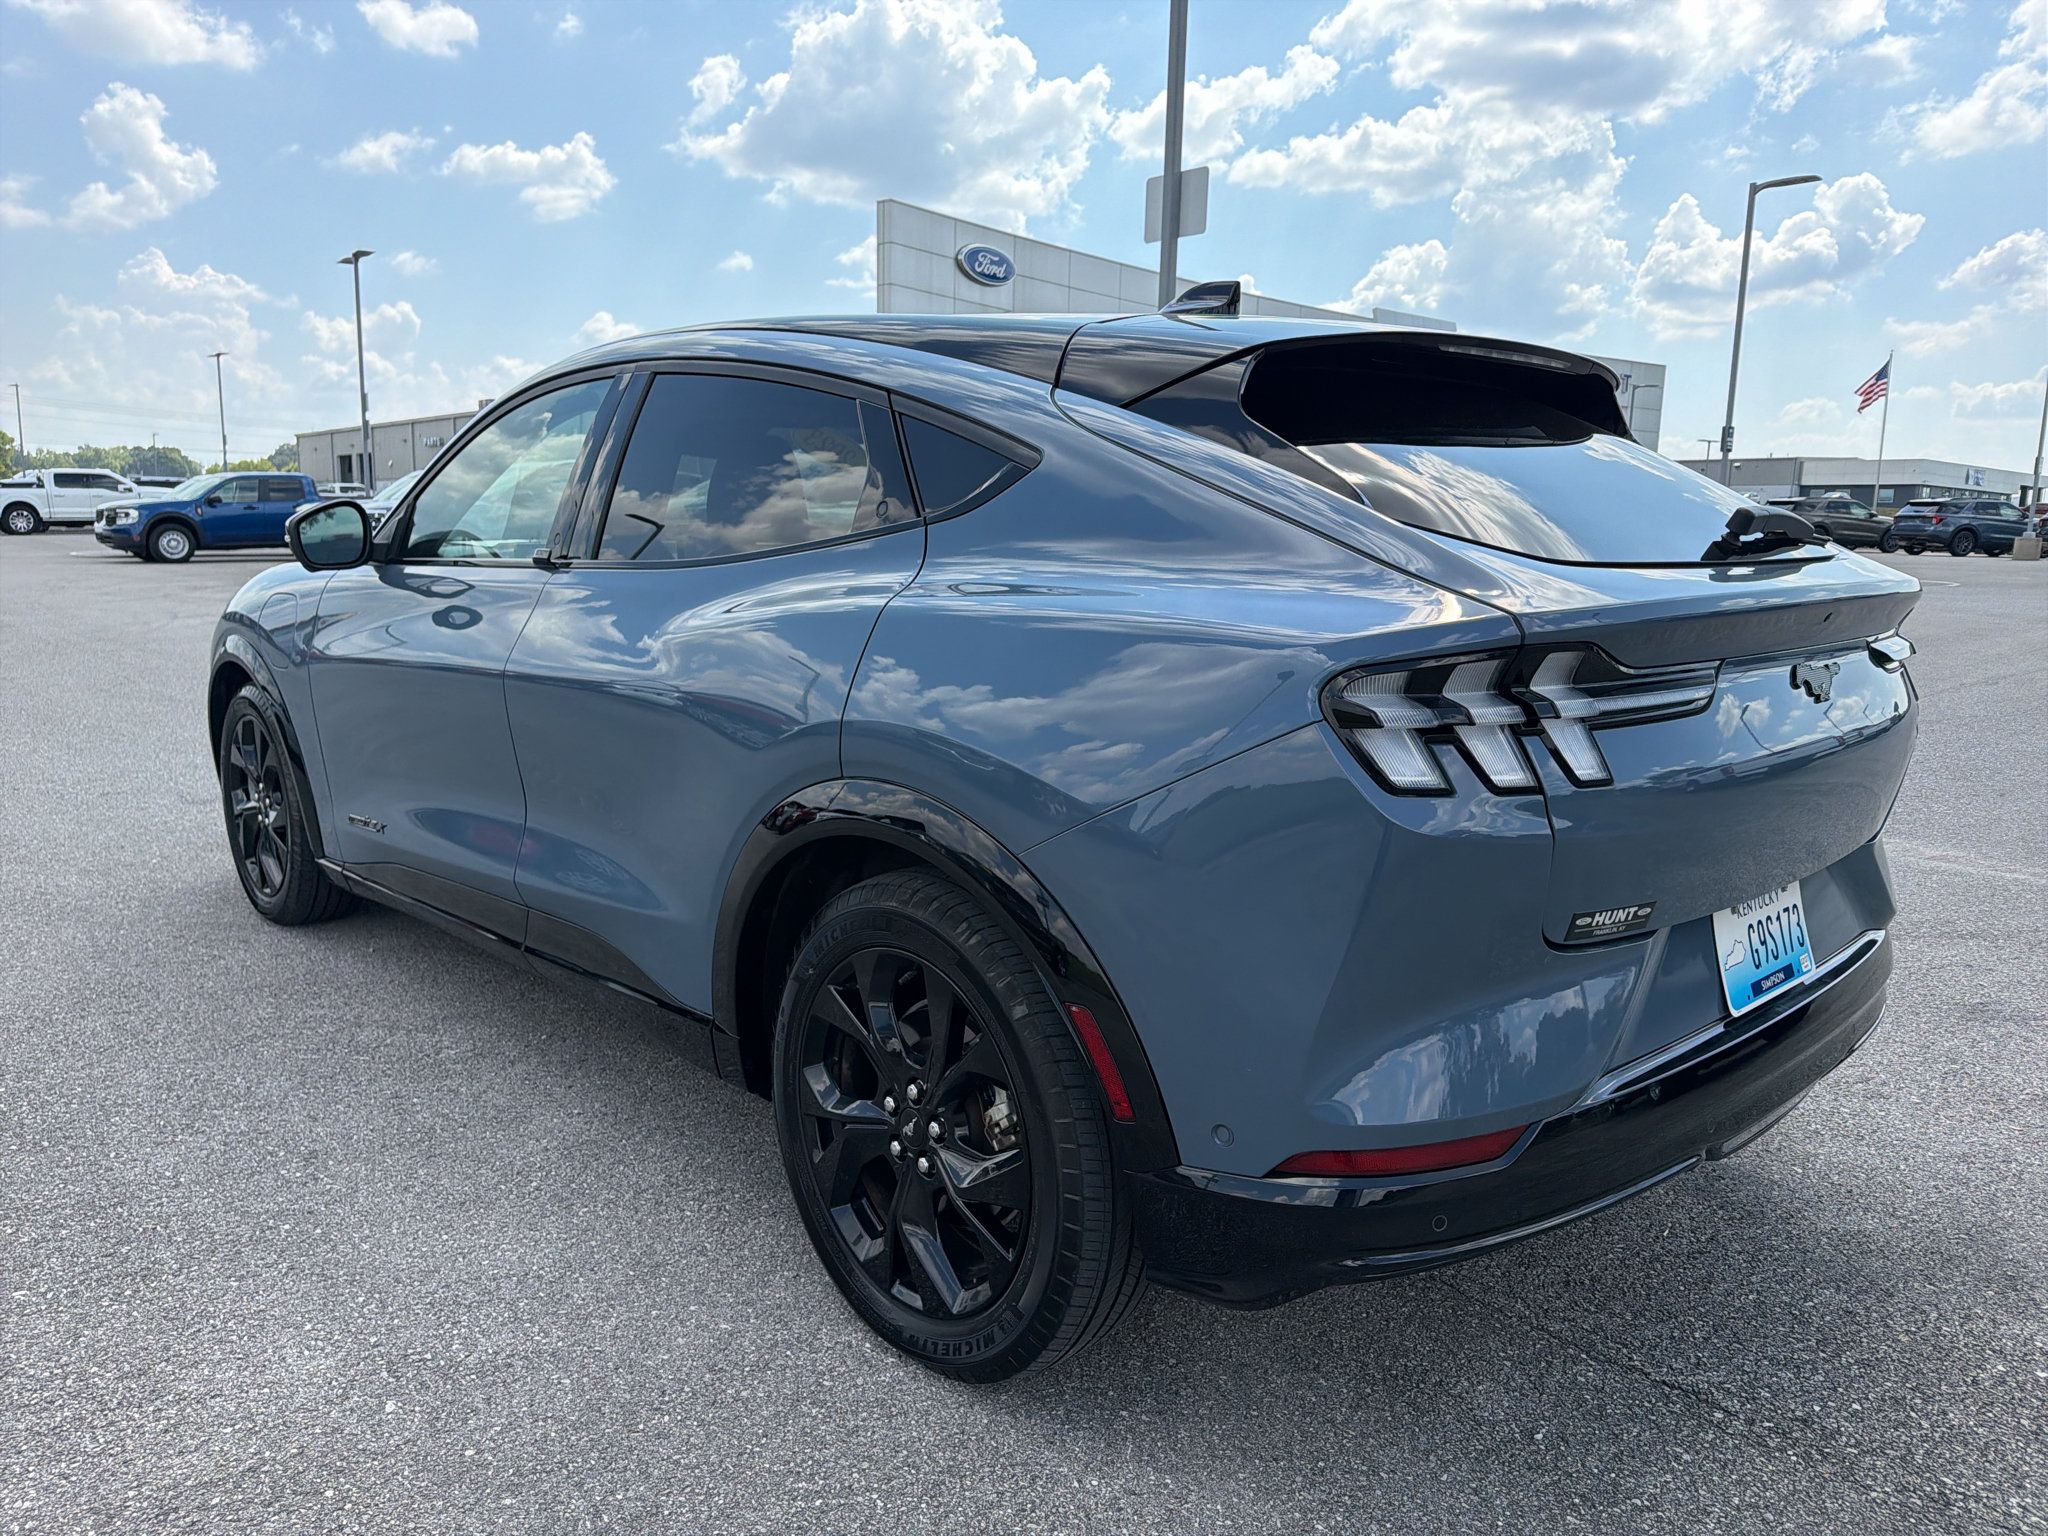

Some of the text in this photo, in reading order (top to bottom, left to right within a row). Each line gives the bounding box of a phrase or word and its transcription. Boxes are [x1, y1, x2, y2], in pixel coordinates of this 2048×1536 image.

[974, 252, 1006, 278] Ford
[1592, 906, 1638, 926] HUNT
[1737, 889, 1780, 919] KENTUCKY
[1747, 903, 1805, 970] G9S173
[1760, 970, 1786, 991] SIMPSON
